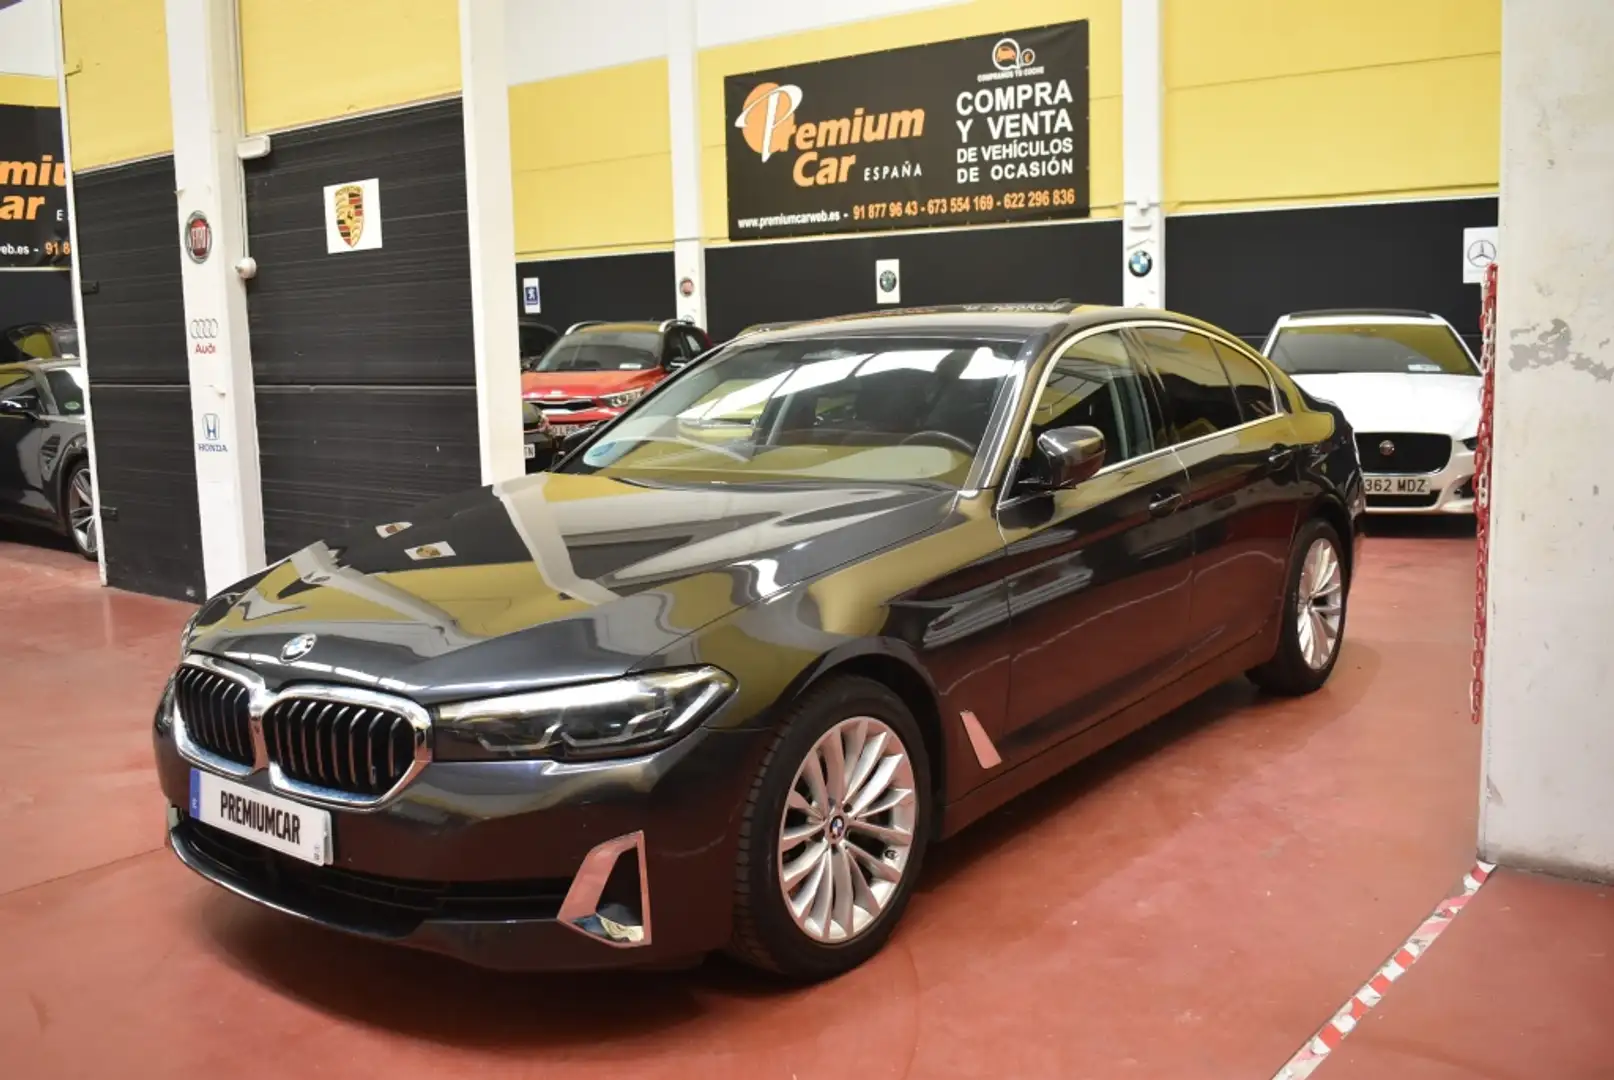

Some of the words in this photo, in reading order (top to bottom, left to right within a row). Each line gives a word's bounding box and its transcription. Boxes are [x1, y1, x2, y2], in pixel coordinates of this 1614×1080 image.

[956, 79, 1073, 116] COMPRA
[734, 83, 925, 163] Premium
[956, 118, 974, 143] Y
[987, 108, 1074, 140] VENTA
[956, 147, 978, 164] DE
[981, 137, 1073, 161] VEHÍCULOS
[793, 151, 857, 187] Car
[863, 160, 923, 181] ESPAÑA
[956, 167, 980, 184] DE
[990, 156, 1073, 181] OCASIÓN
[737, 209, 841, 230] www.premiumcarweb.es
[853, 204, 865, 220] 91
[868, 203, 887, 219] 877
[889, 201, 903, 218] 96
[904, 200, 919, 217] 43
[927, 198, 947, 215] 673
[950, 196, 970, 213] 554
[973, 194, 994, 211] 169
[1004, 192, 1025, 209] 622
[1028, 190, 1049, 208] 296
[1052, 188, 1075, 206] 836
[45, 241, 59, 255] 91
[195, 342, 216, 354] Audi
[197, 444, 228, 453] HONDA
[1364, 478, 1392, 492] 362
[1397, 478, 1426, 492] MDZ
[220, 790, 300, 845] PREMIUMCAR
